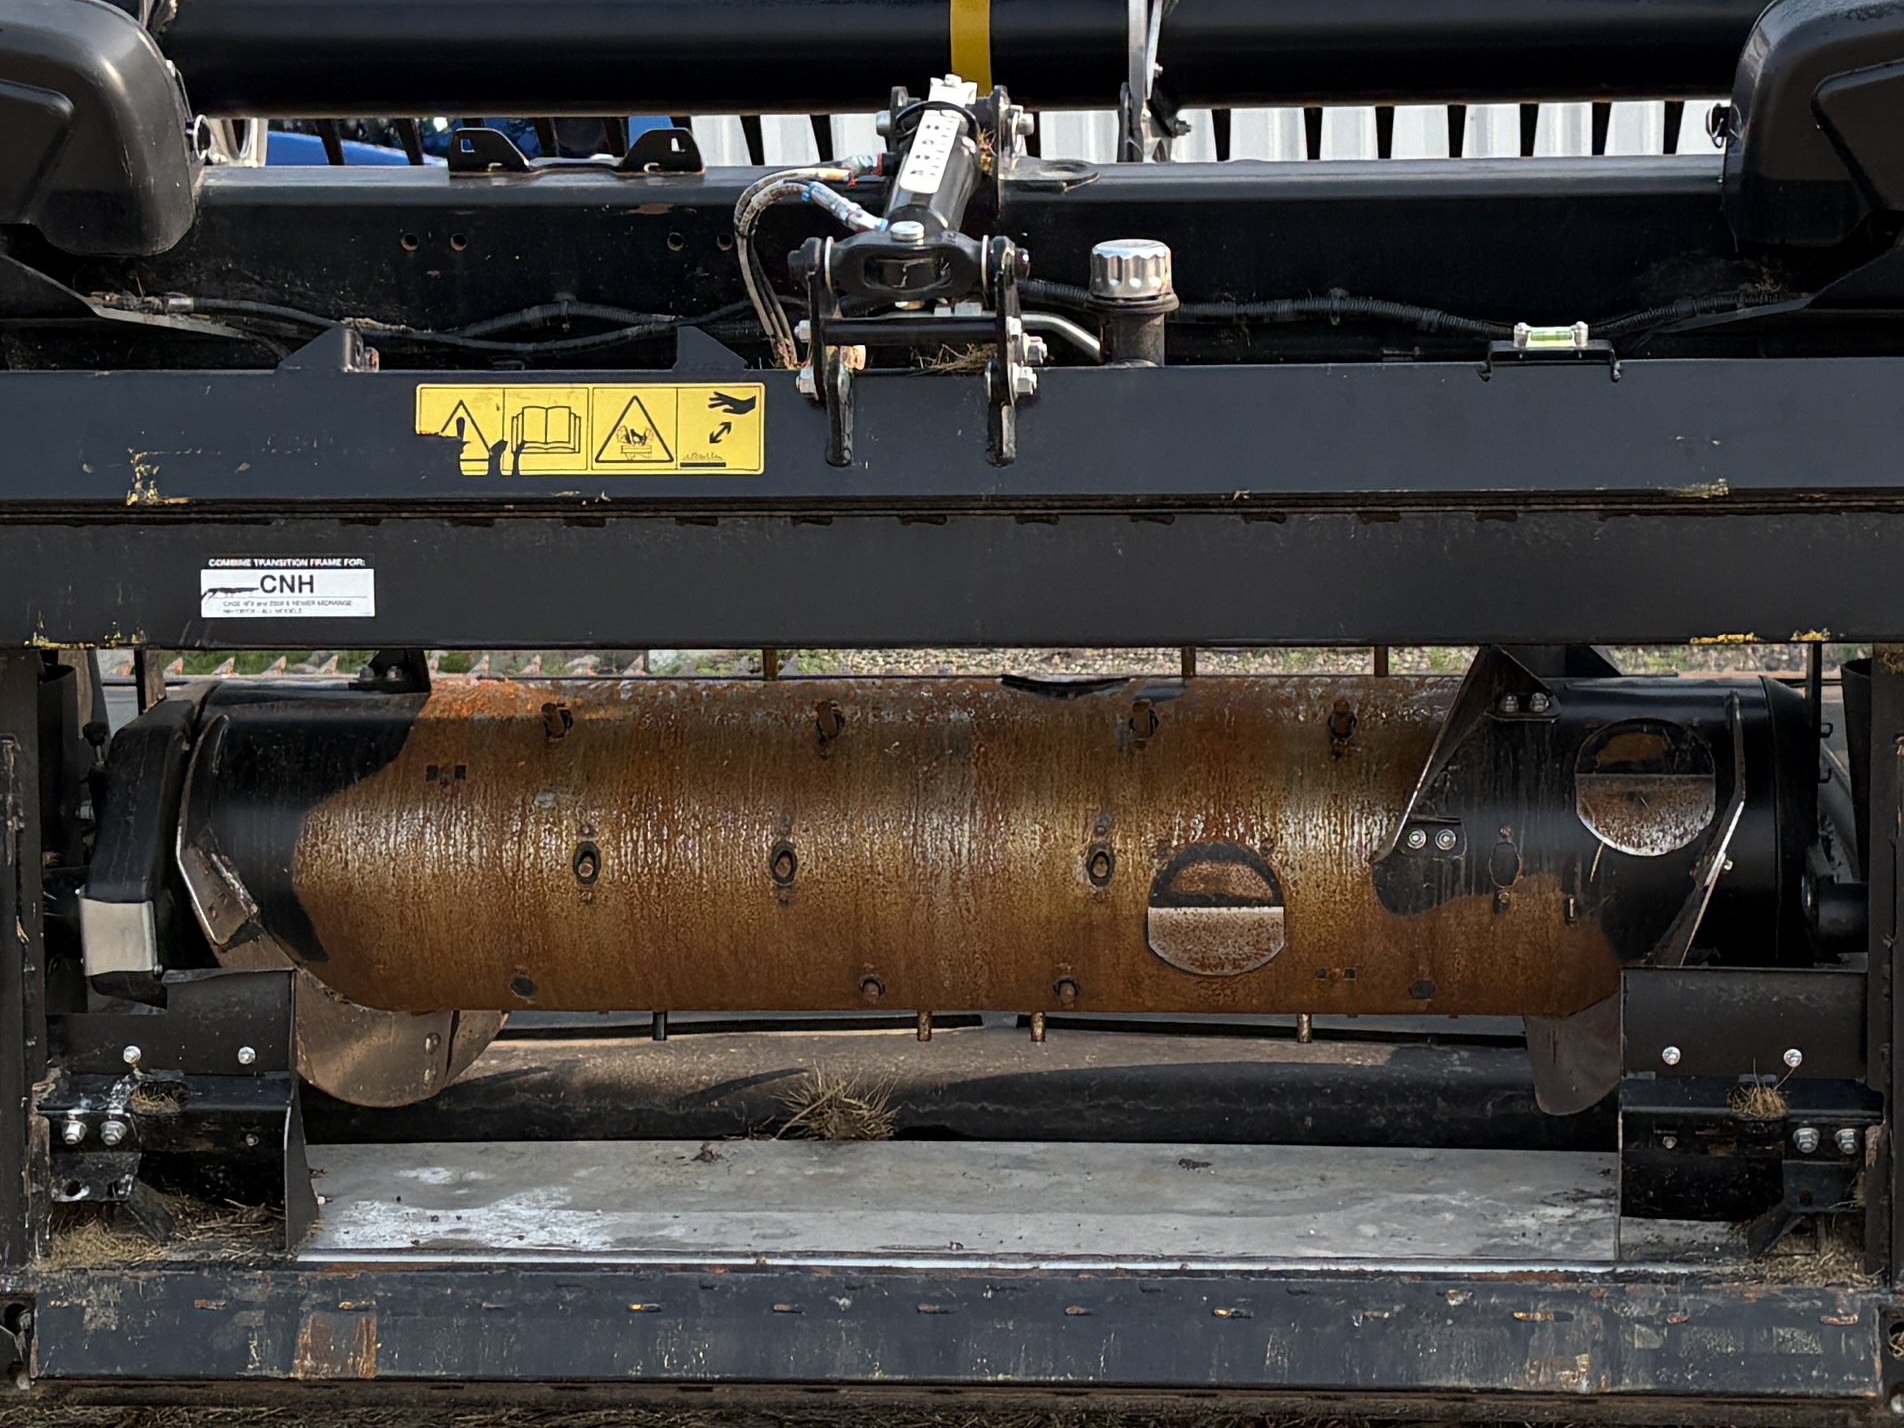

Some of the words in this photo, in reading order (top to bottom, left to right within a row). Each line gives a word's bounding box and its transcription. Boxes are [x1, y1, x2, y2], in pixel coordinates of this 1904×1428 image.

[208, 558, 252, 567] COMBINE
[254, 558, 309, 567] TRANSITION
[310, 558, 342, 567] FRAME
[343, 558, 366, 567] FOR:
[260, 574, 314, 594] CNH
